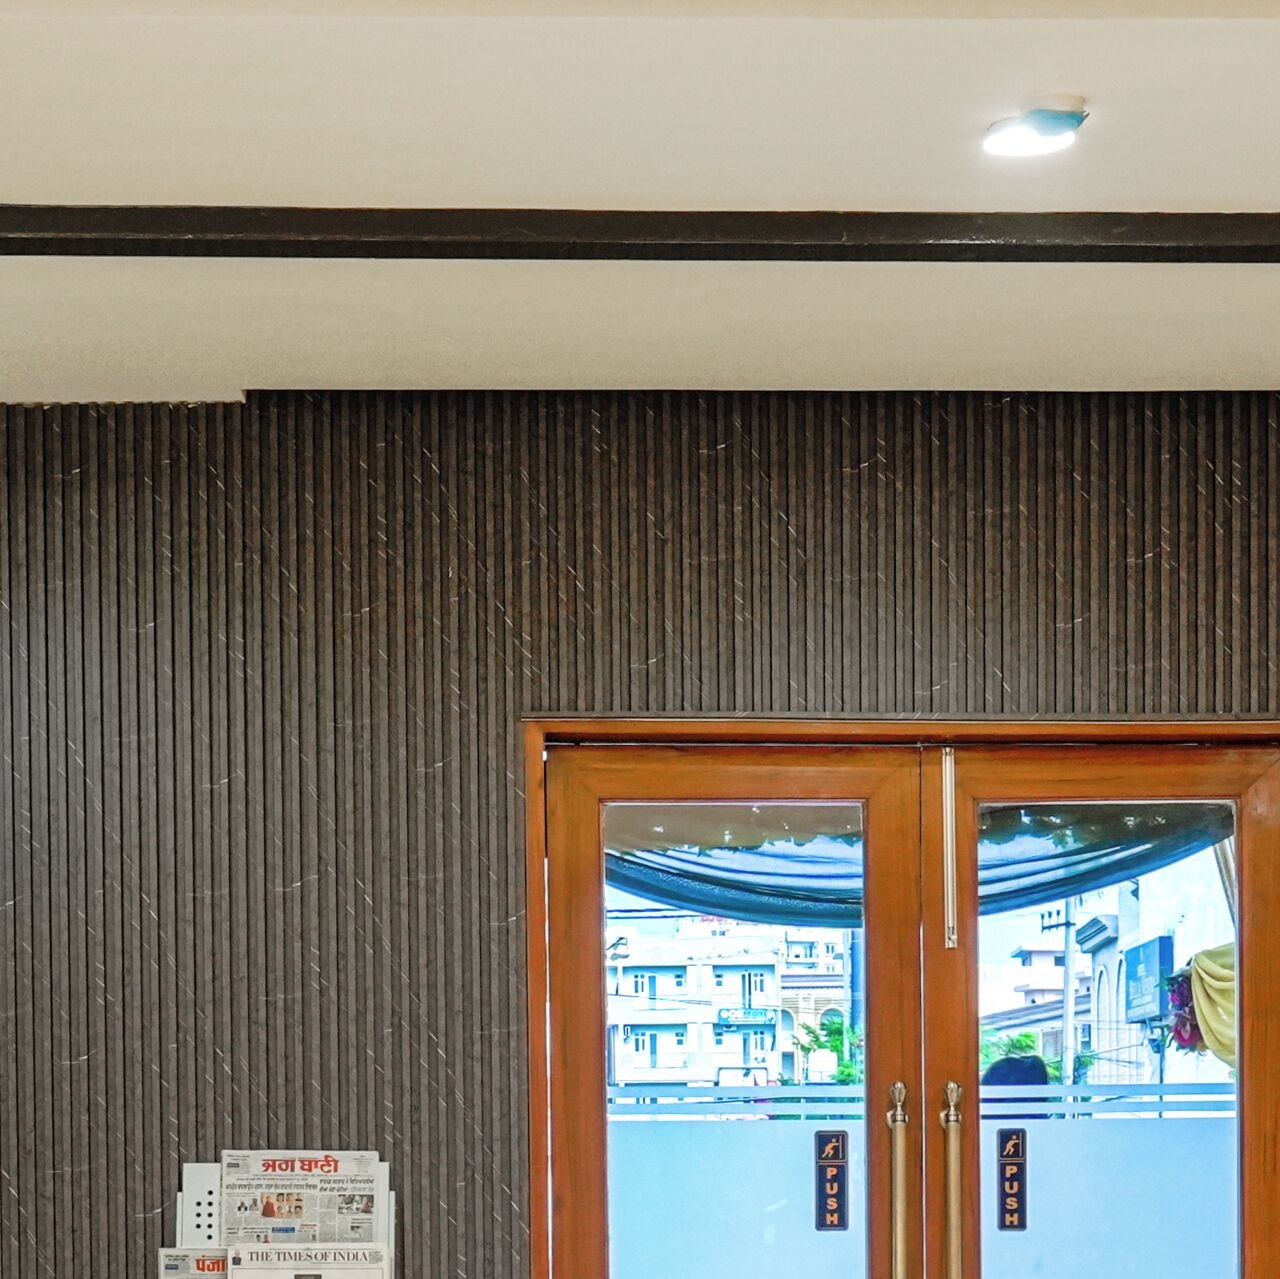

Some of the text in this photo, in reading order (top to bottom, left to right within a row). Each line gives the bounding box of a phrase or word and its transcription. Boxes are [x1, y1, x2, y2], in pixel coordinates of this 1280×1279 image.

[298, 1154, 339, 1174] ਬਾਣੀ
[826, 1167, 839, 1225] PUSH
[1004, 1165, 1019, 1226] PUSH
[195, 1255, 227, 1273] पंजा
[248, 1251, 368, 1262] THE TIMES OF INDIA
